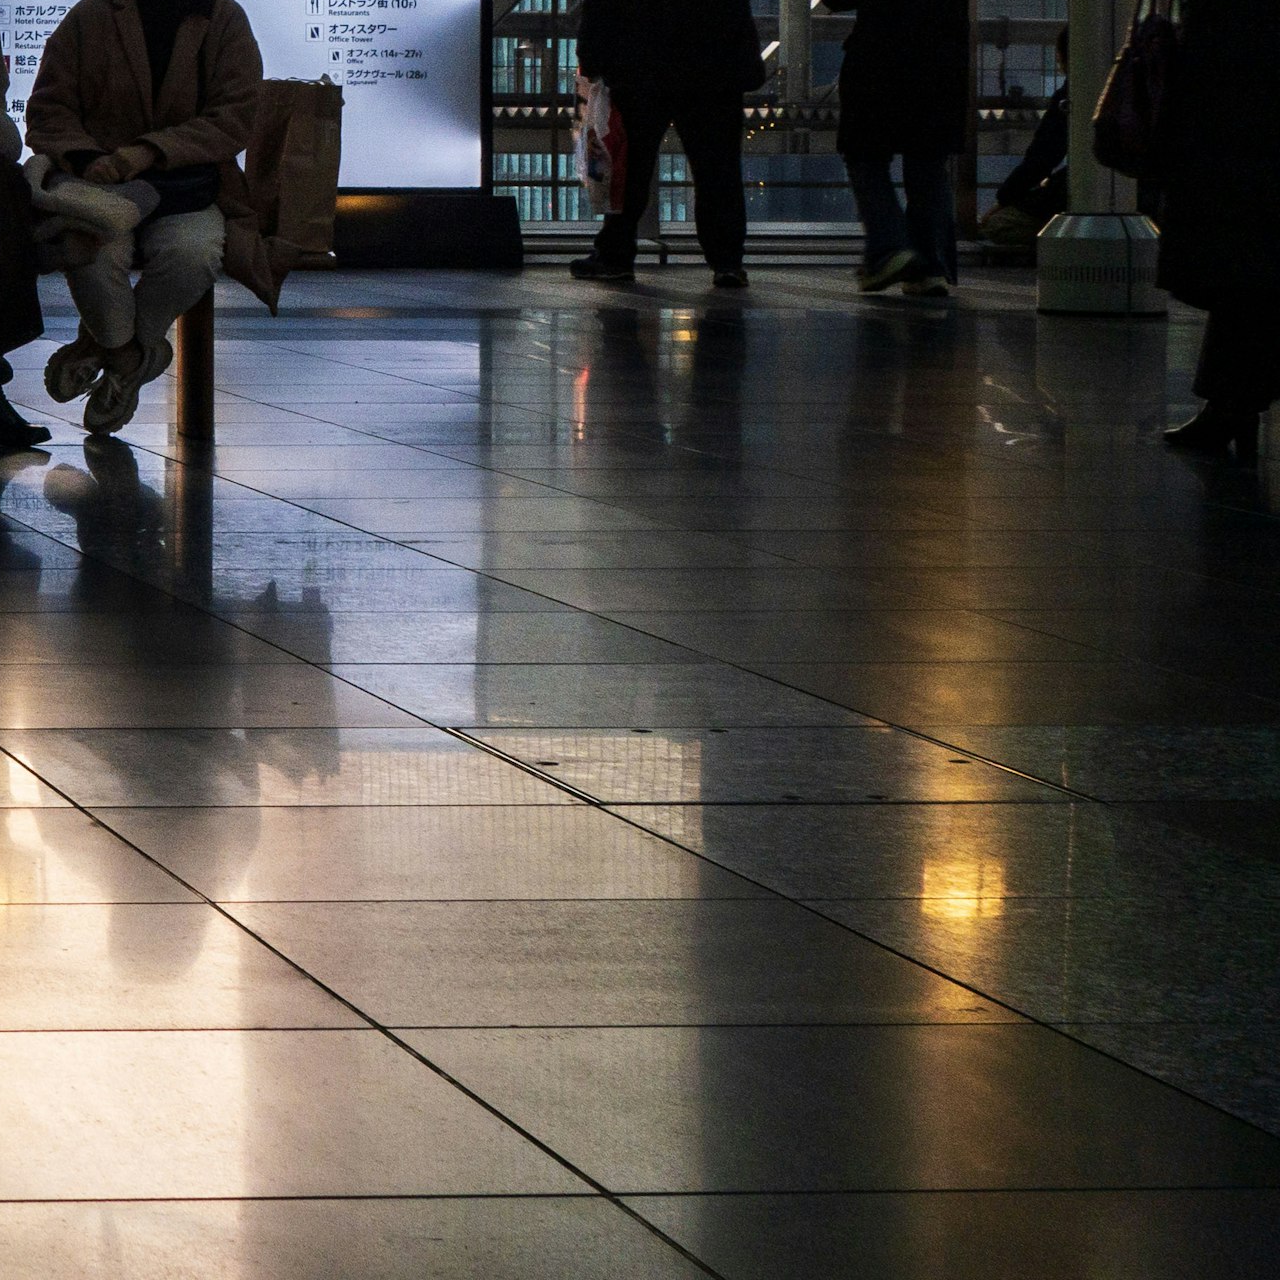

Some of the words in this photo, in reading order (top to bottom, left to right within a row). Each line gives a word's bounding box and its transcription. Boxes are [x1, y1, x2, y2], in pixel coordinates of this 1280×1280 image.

[391, 0, 417, 9] (10F)
[329, 24, 398, 35] オフィスタワー
[346, 49, 378, 58] オフィス
[15, 55, 42, 66] 総合
[346, 70, 404, 79] ラグナヴェール
